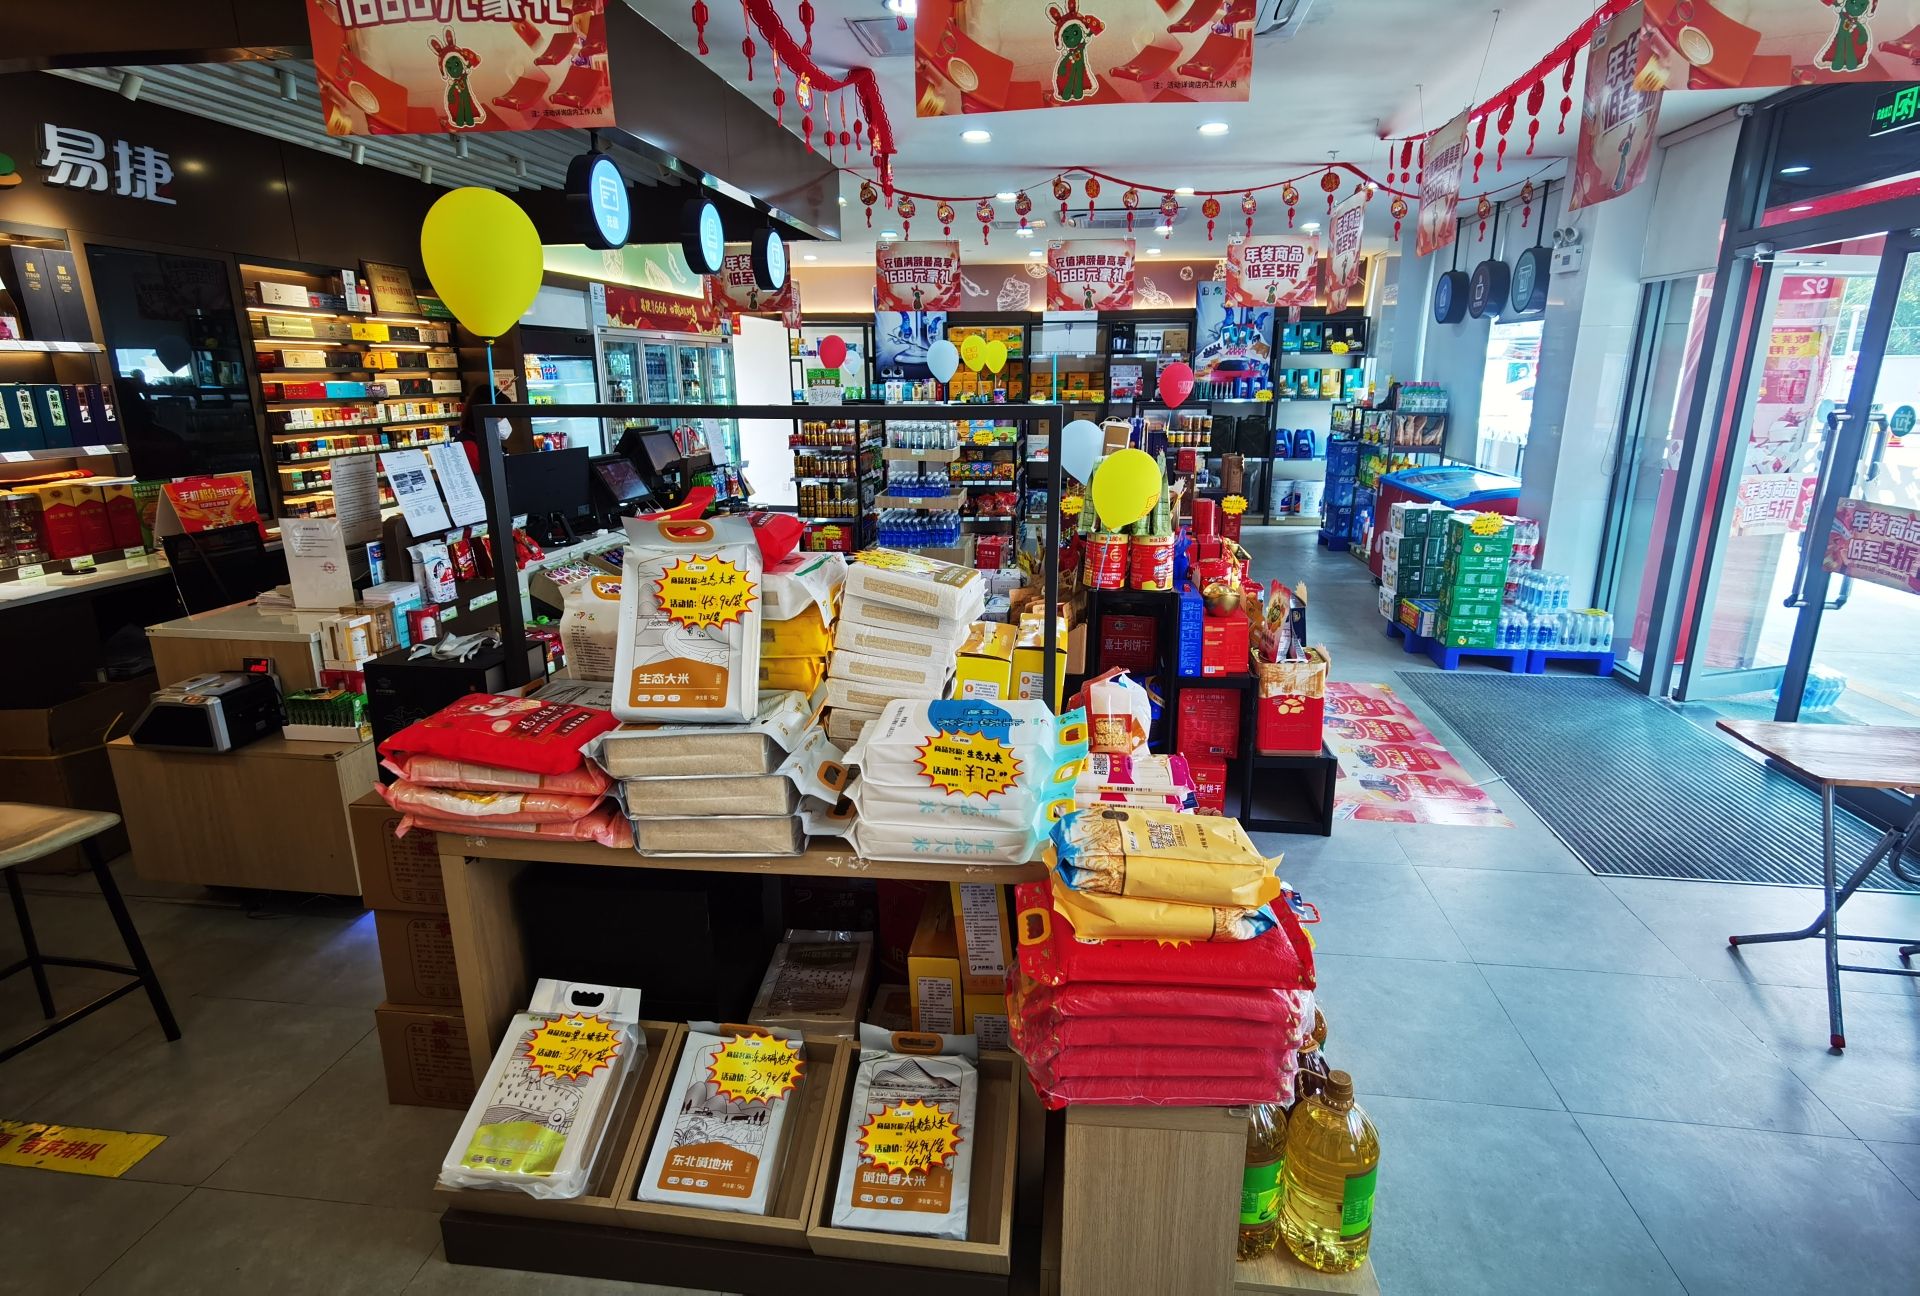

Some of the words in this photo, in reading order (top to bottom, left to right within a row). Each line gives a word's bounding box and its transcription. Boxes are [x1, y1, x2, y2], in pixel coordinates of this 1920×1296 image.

[42, 123, 177, 205] 易捷
[1336, 205, 1361, 237] 年货商品
[725, 254, 752, 271] 年货
[884, 256, 953, 269] 充值满额最高享
[1055, 255, 1127, 269] 充值满额最高享
[1245, 245, 1304, 263] 年货商品
[728, 271, 756, 286] 低至
[884, 266, 953, 286] 1688元豪礼
[1055, 266, 1126, 285] 1688元豪礼
[1246, 263, 1300, 279] 低至5折
[1745, 480, 1799, 500] 年货商品
[1743, 500, 1796, 523] 低至5折
[1852, 510, 1920, 545] 年货商品
[1847, 537, 1919, 573] 低至5折
[670, 599, 697, 608] 活动价:
[1104, 638, 1151, 651] 嘉士利饼干
[639, 673, 689, 685] 生态大米
[932, 766, 962, 776] 活动价:
[672, 1154, 734, 1172] 东北碱地米
[863, 1171, 927, 1187] 碱地香大米
